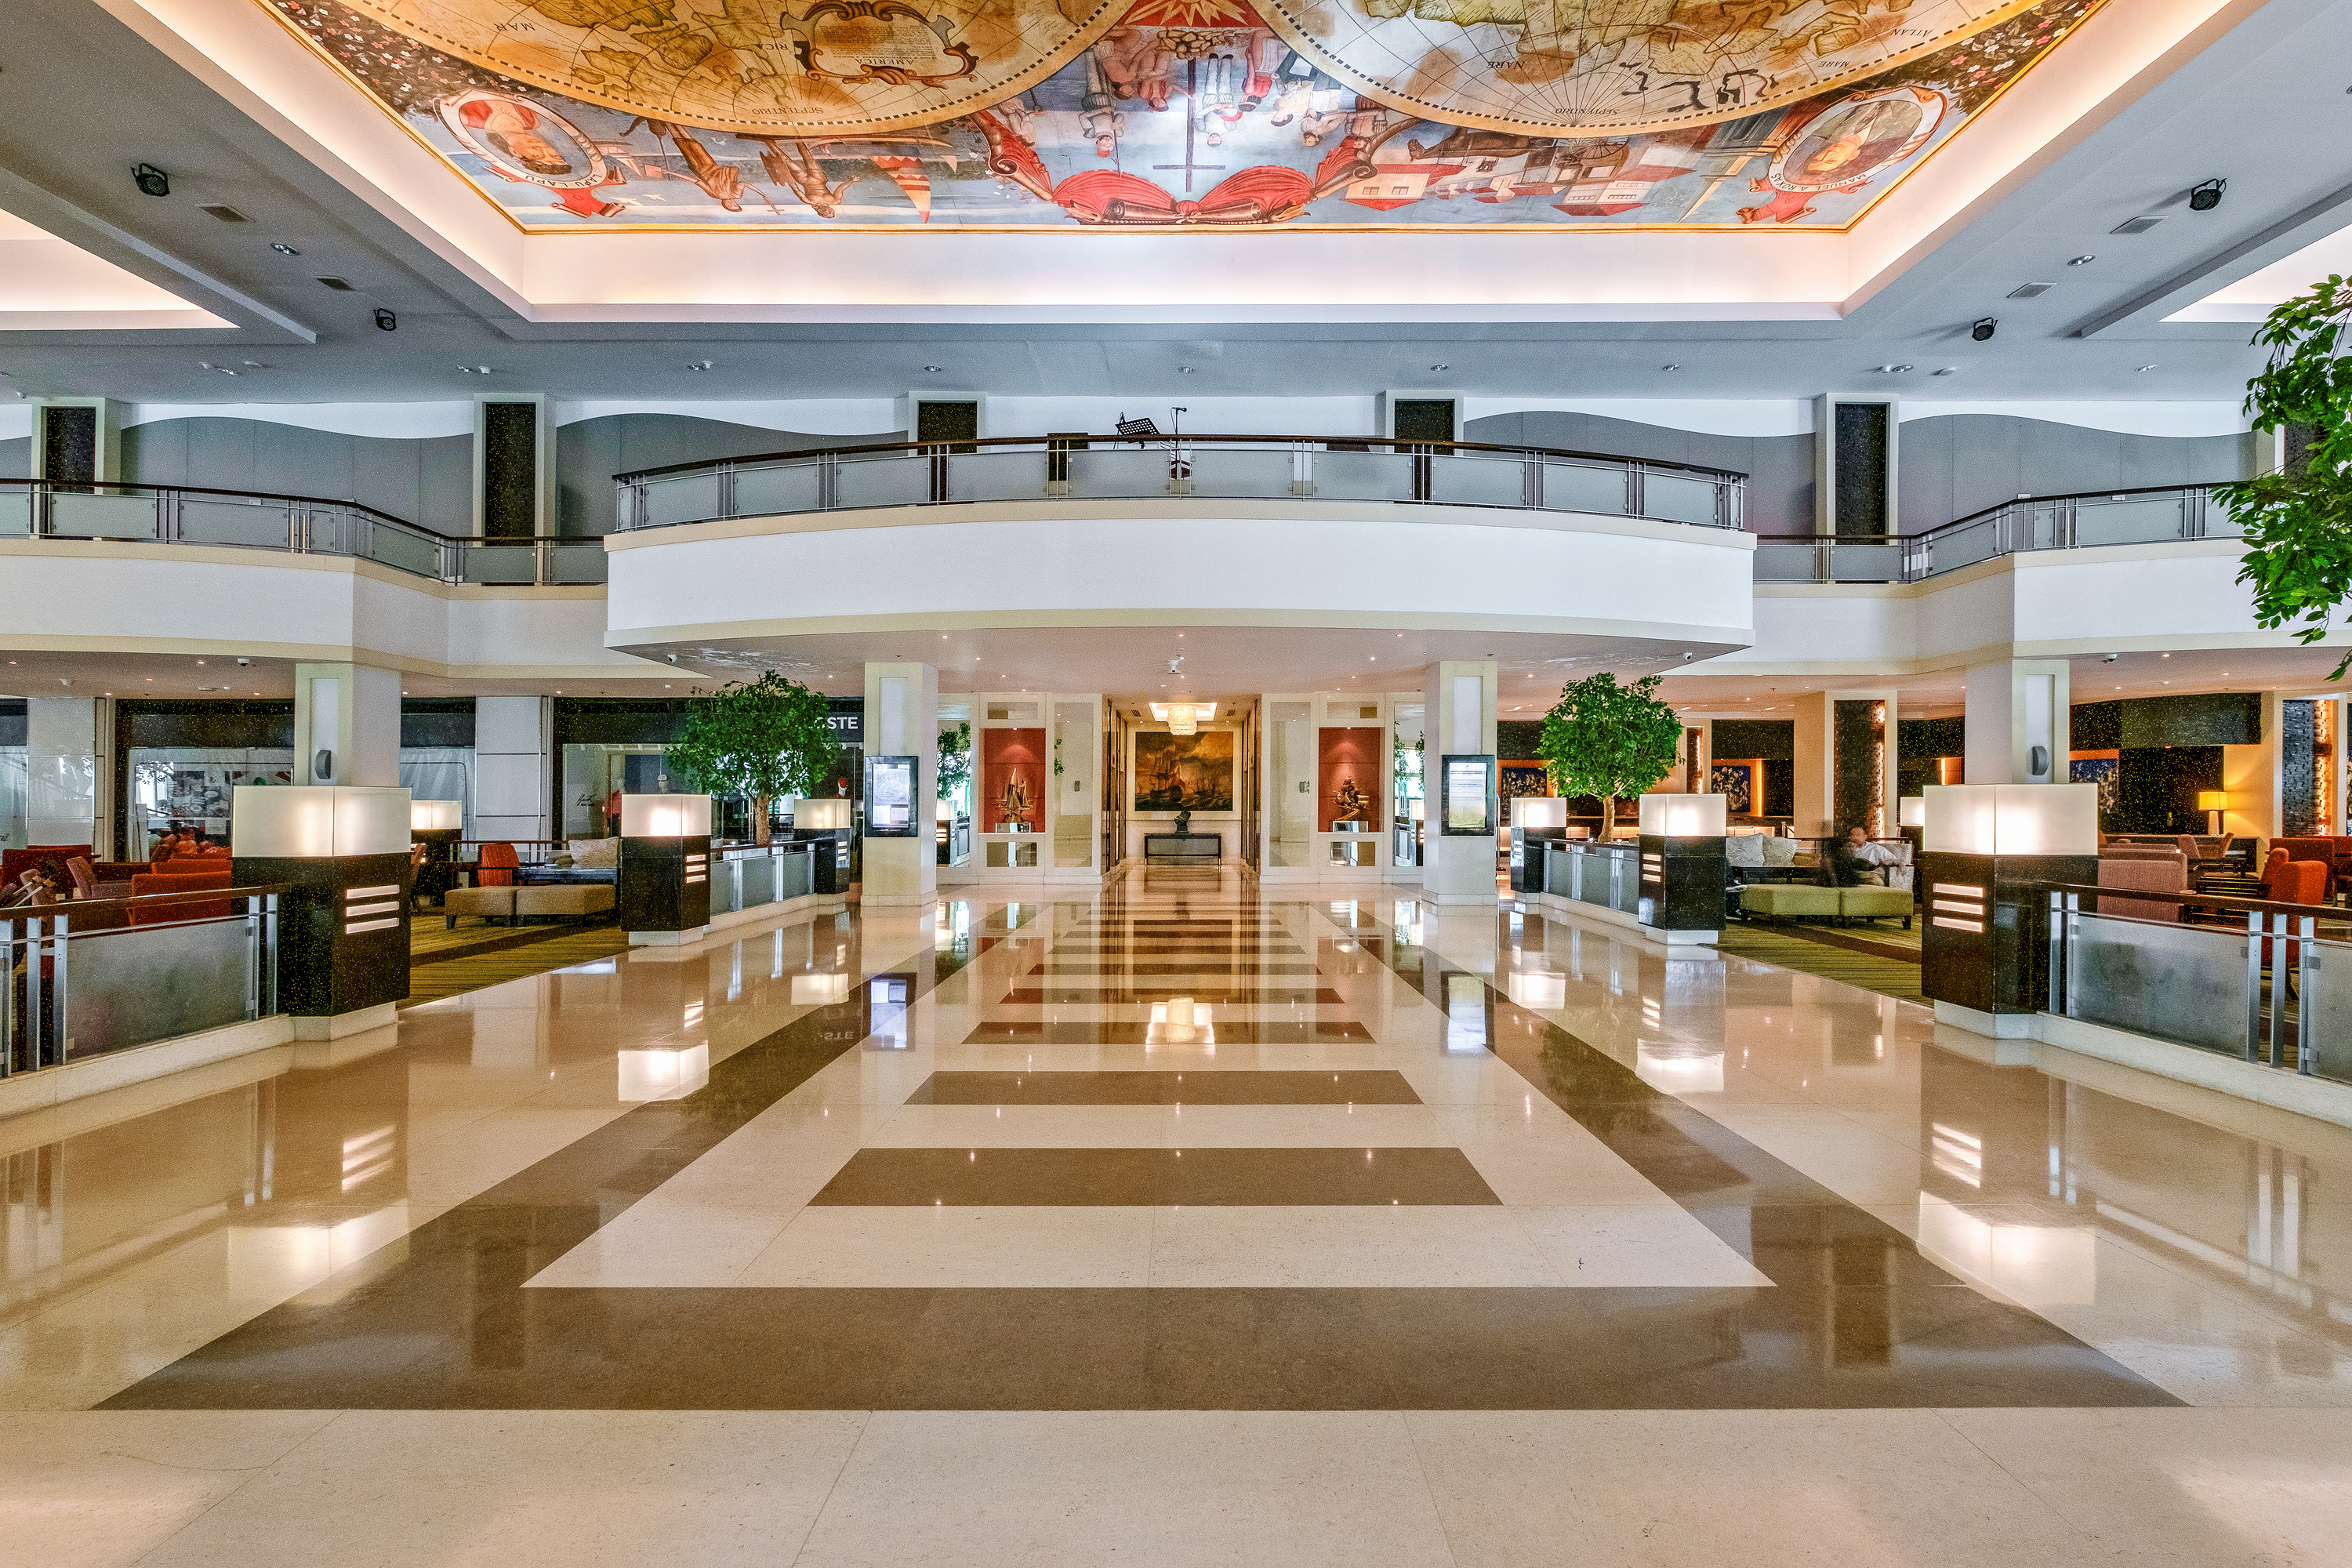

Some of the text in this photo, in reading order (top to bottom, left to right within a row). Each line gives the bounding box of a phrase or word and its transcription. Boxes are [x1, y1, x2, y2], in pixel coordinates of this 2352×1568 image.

[1817, 60, 1851, 69] MARE
[525, 174, 603, 188] LAPU LAPU
[1771, 172, 1797, 191] ROXAS
[1815, 173, 1867, 191] MANUEL
